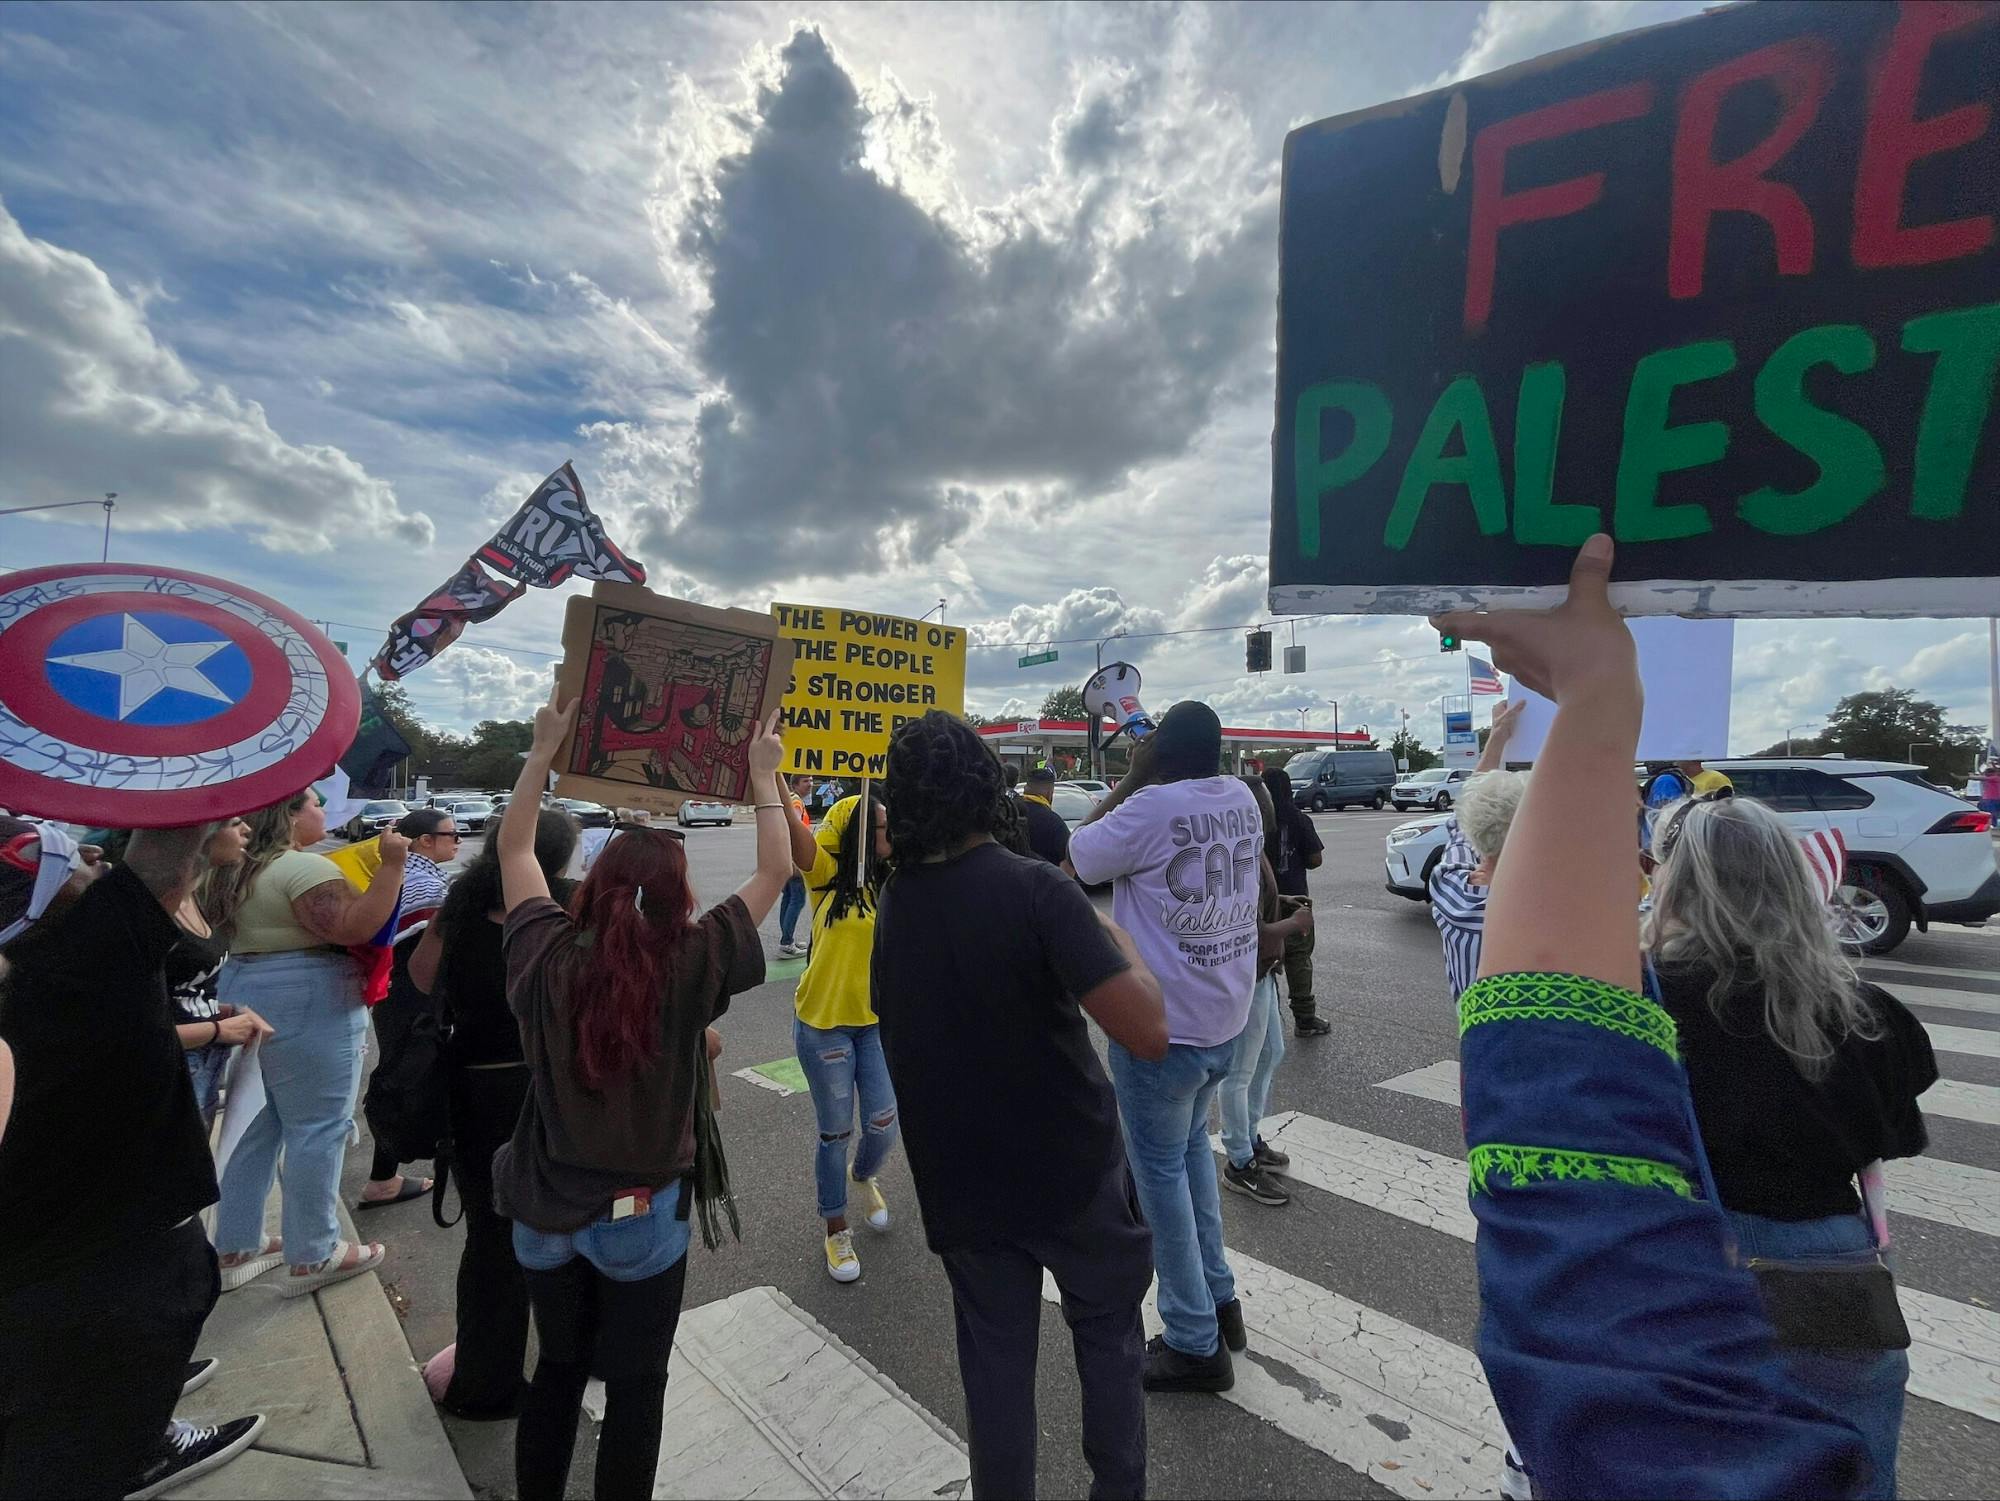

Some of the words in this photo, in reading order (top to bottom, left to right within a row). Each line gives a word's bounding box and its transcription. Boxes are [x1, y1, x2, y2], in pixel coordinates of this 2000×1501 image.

[521, 552, 548, 578] Trum
[777, 606, 825, 630] THE
[840, 611, 918, 642] POWER
[927, 628, 956, 650] OF
[791, 638, 837, 661] THE
[845, 642, 934, 675] PEOPLE
[784, 675, 797, 694] S
[808, 672, 936, 704] STRONGER
[780, 706, 831, 730] HAN
[840, 711, 883, 733] THE
[794, 748, 823, 771] IN
[832, 750, 888, 774] POW
[1178, 941, 1218, 956] ESCAPE
[1187, 956, 1208, 967] ONE
